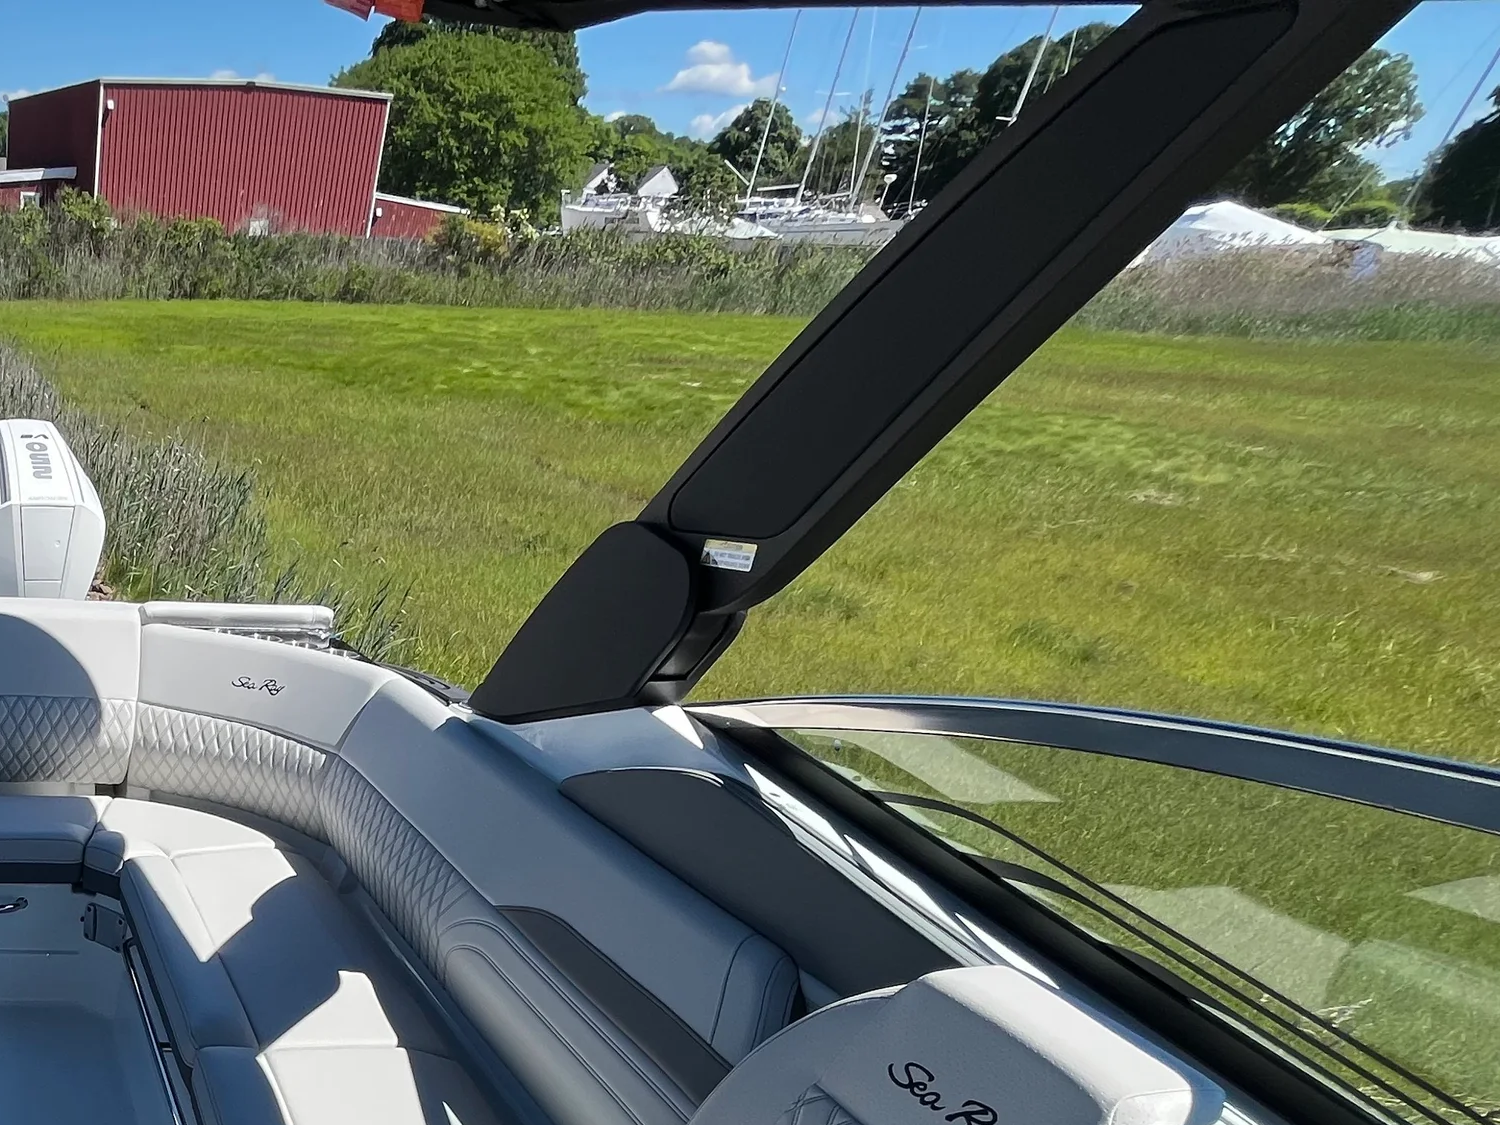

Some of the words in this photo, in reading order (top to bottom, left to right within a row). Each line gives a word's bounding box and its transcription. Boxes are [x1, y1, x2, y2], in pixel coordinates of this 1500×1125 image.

[231, 676, 258, 690] Sea
[258, 679, 286, 696] Ray
[887, 1062, 946, 1111] Sea
